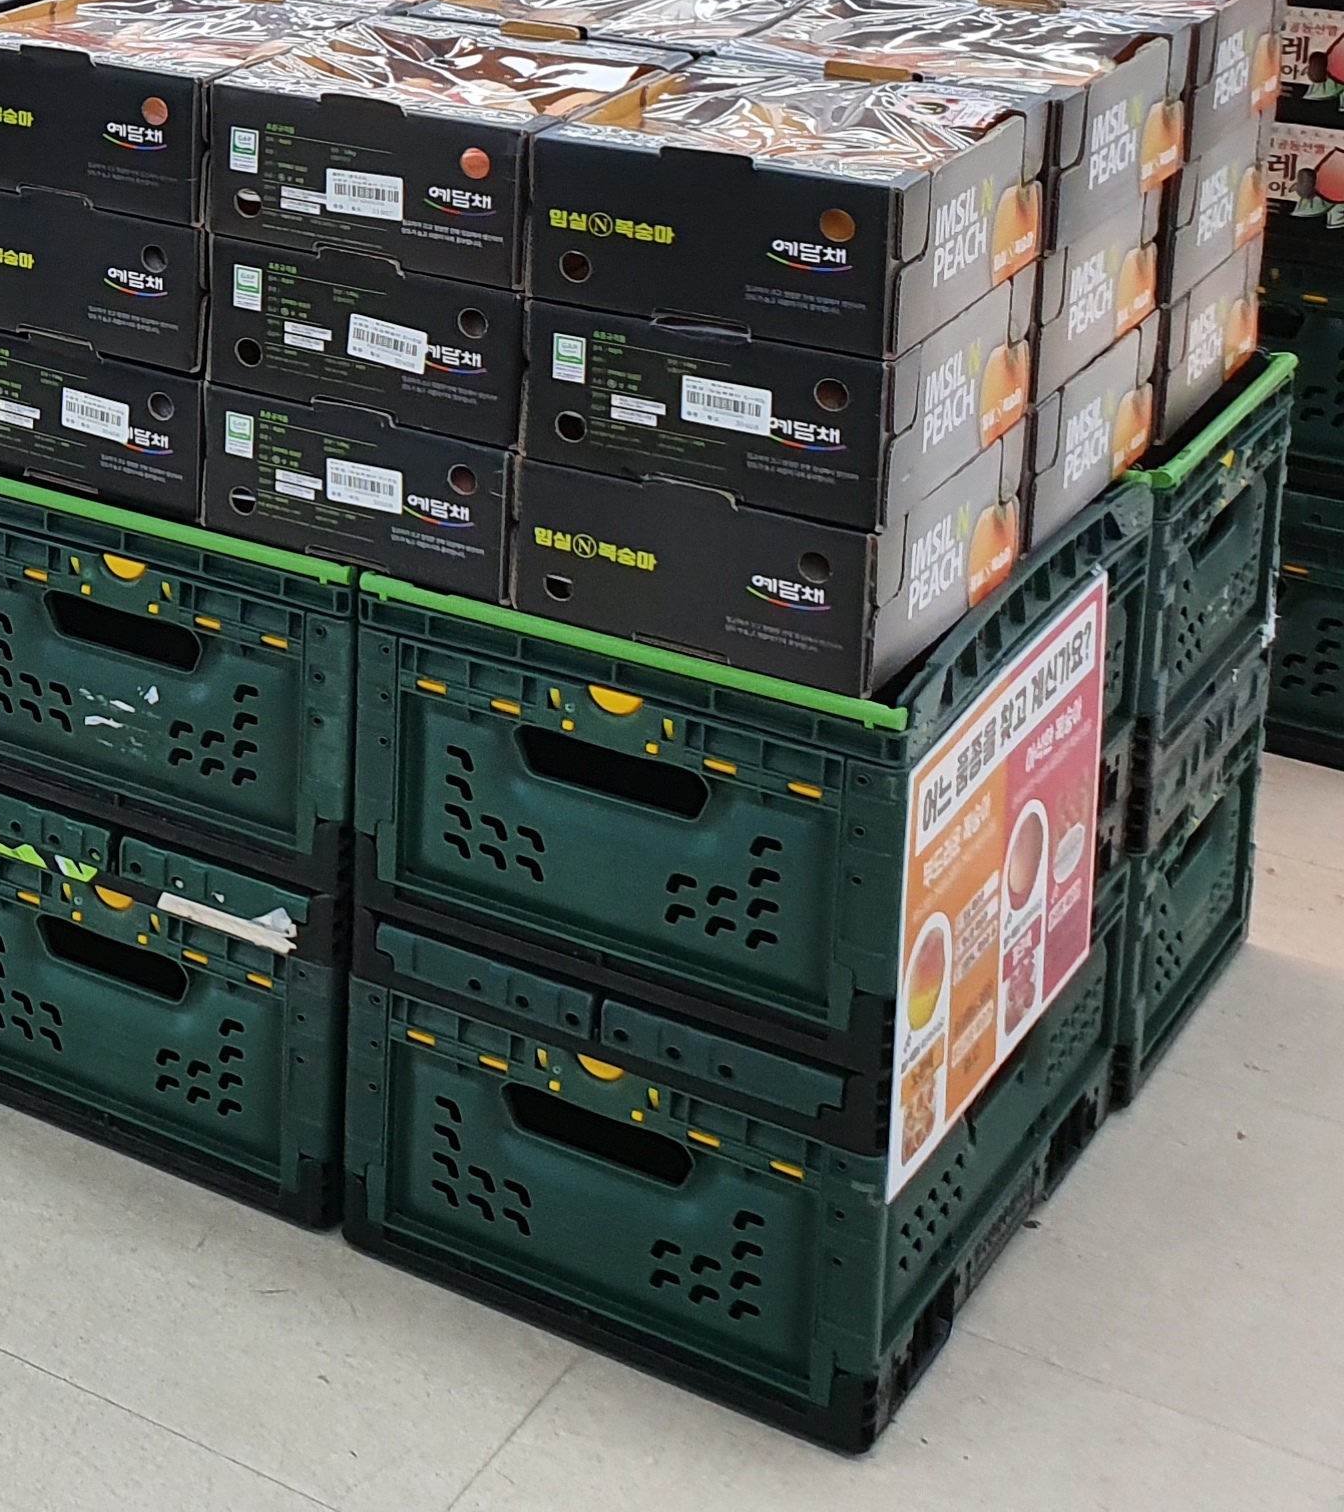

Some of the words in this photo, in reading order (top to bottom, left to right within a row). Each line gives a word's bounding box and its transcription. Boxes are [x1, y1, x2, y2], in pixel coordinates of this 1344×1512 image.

[107, 121, 164, 145] 예담채
[427, 186, 493, 212] 예담채
[771, 238, 848, 266] 예담채
[932, 221, 987, 289] PEACH
[107, 266, 164, 291] 예담채
[921, 384, 975, 454] PEACH
[750, 573, 825, 607] 예담채
[922, 774, 953, 833] 어느
[1031, 620, 1093, 714] 계신가요?
